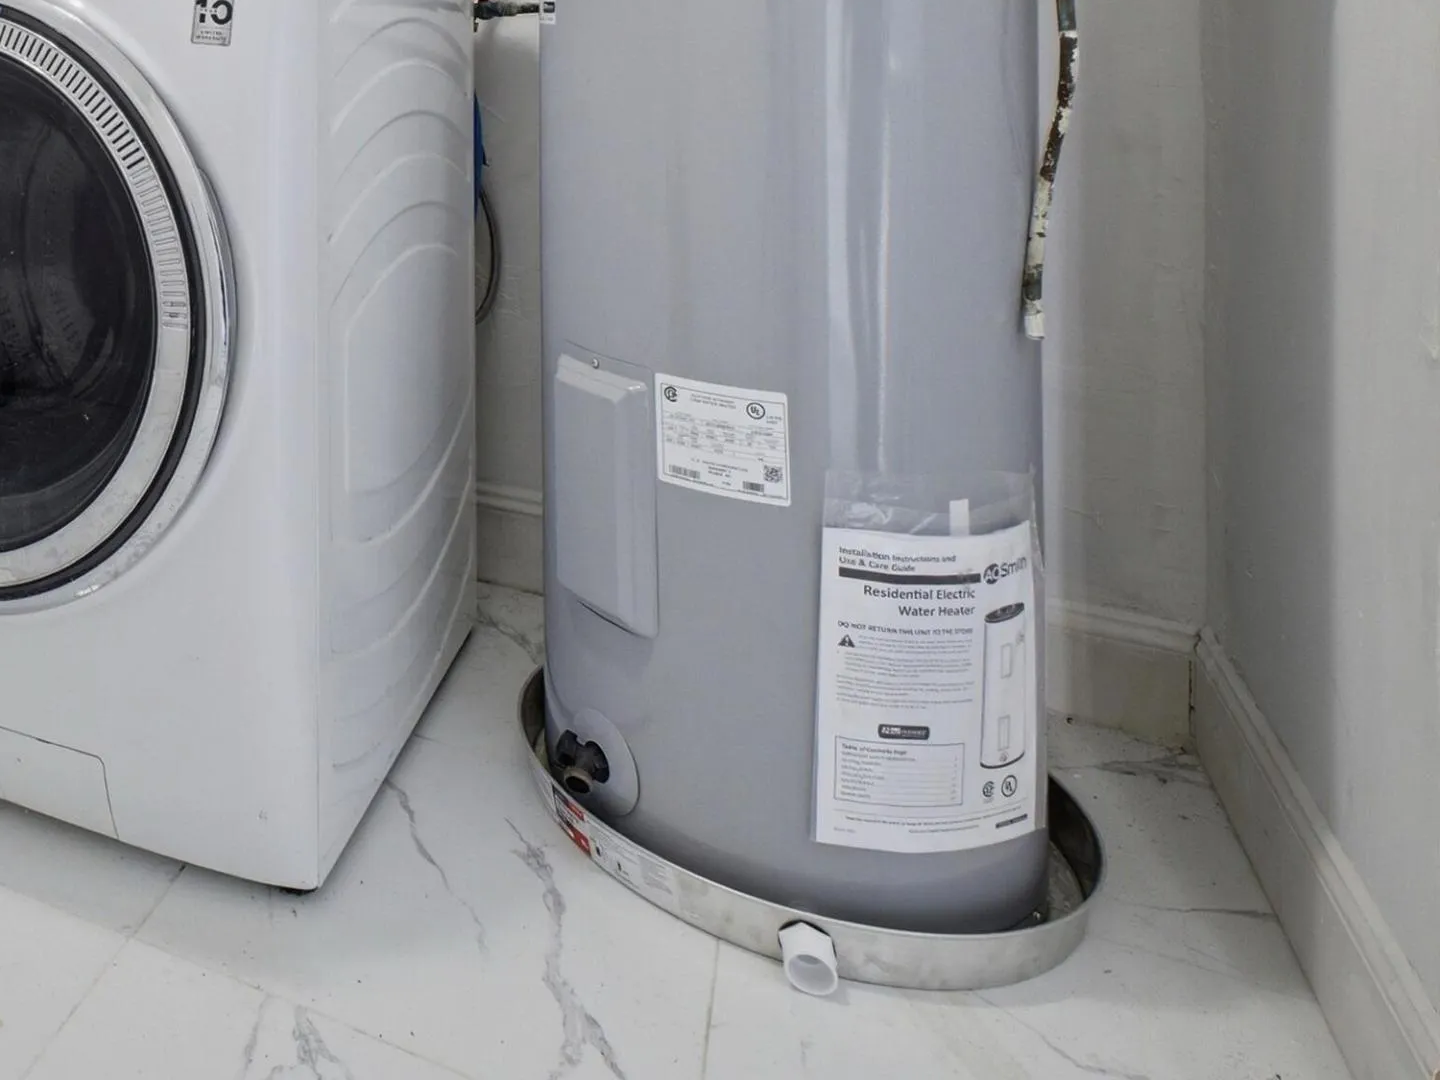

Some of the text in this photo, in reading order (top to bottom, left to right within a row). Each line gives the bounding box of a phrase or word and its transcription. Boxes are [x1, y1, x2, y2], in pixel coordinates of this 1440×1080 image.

[838, 545, 957, 563] Installation Instructions and
[838, 556, 856, 566] Use
[868, 560, 889, 571] Care
[891, 562, 916, 572] Guide
[863, 584, 976, 600] Residential Electric
[898, 605, 976, 617] Water Heater
